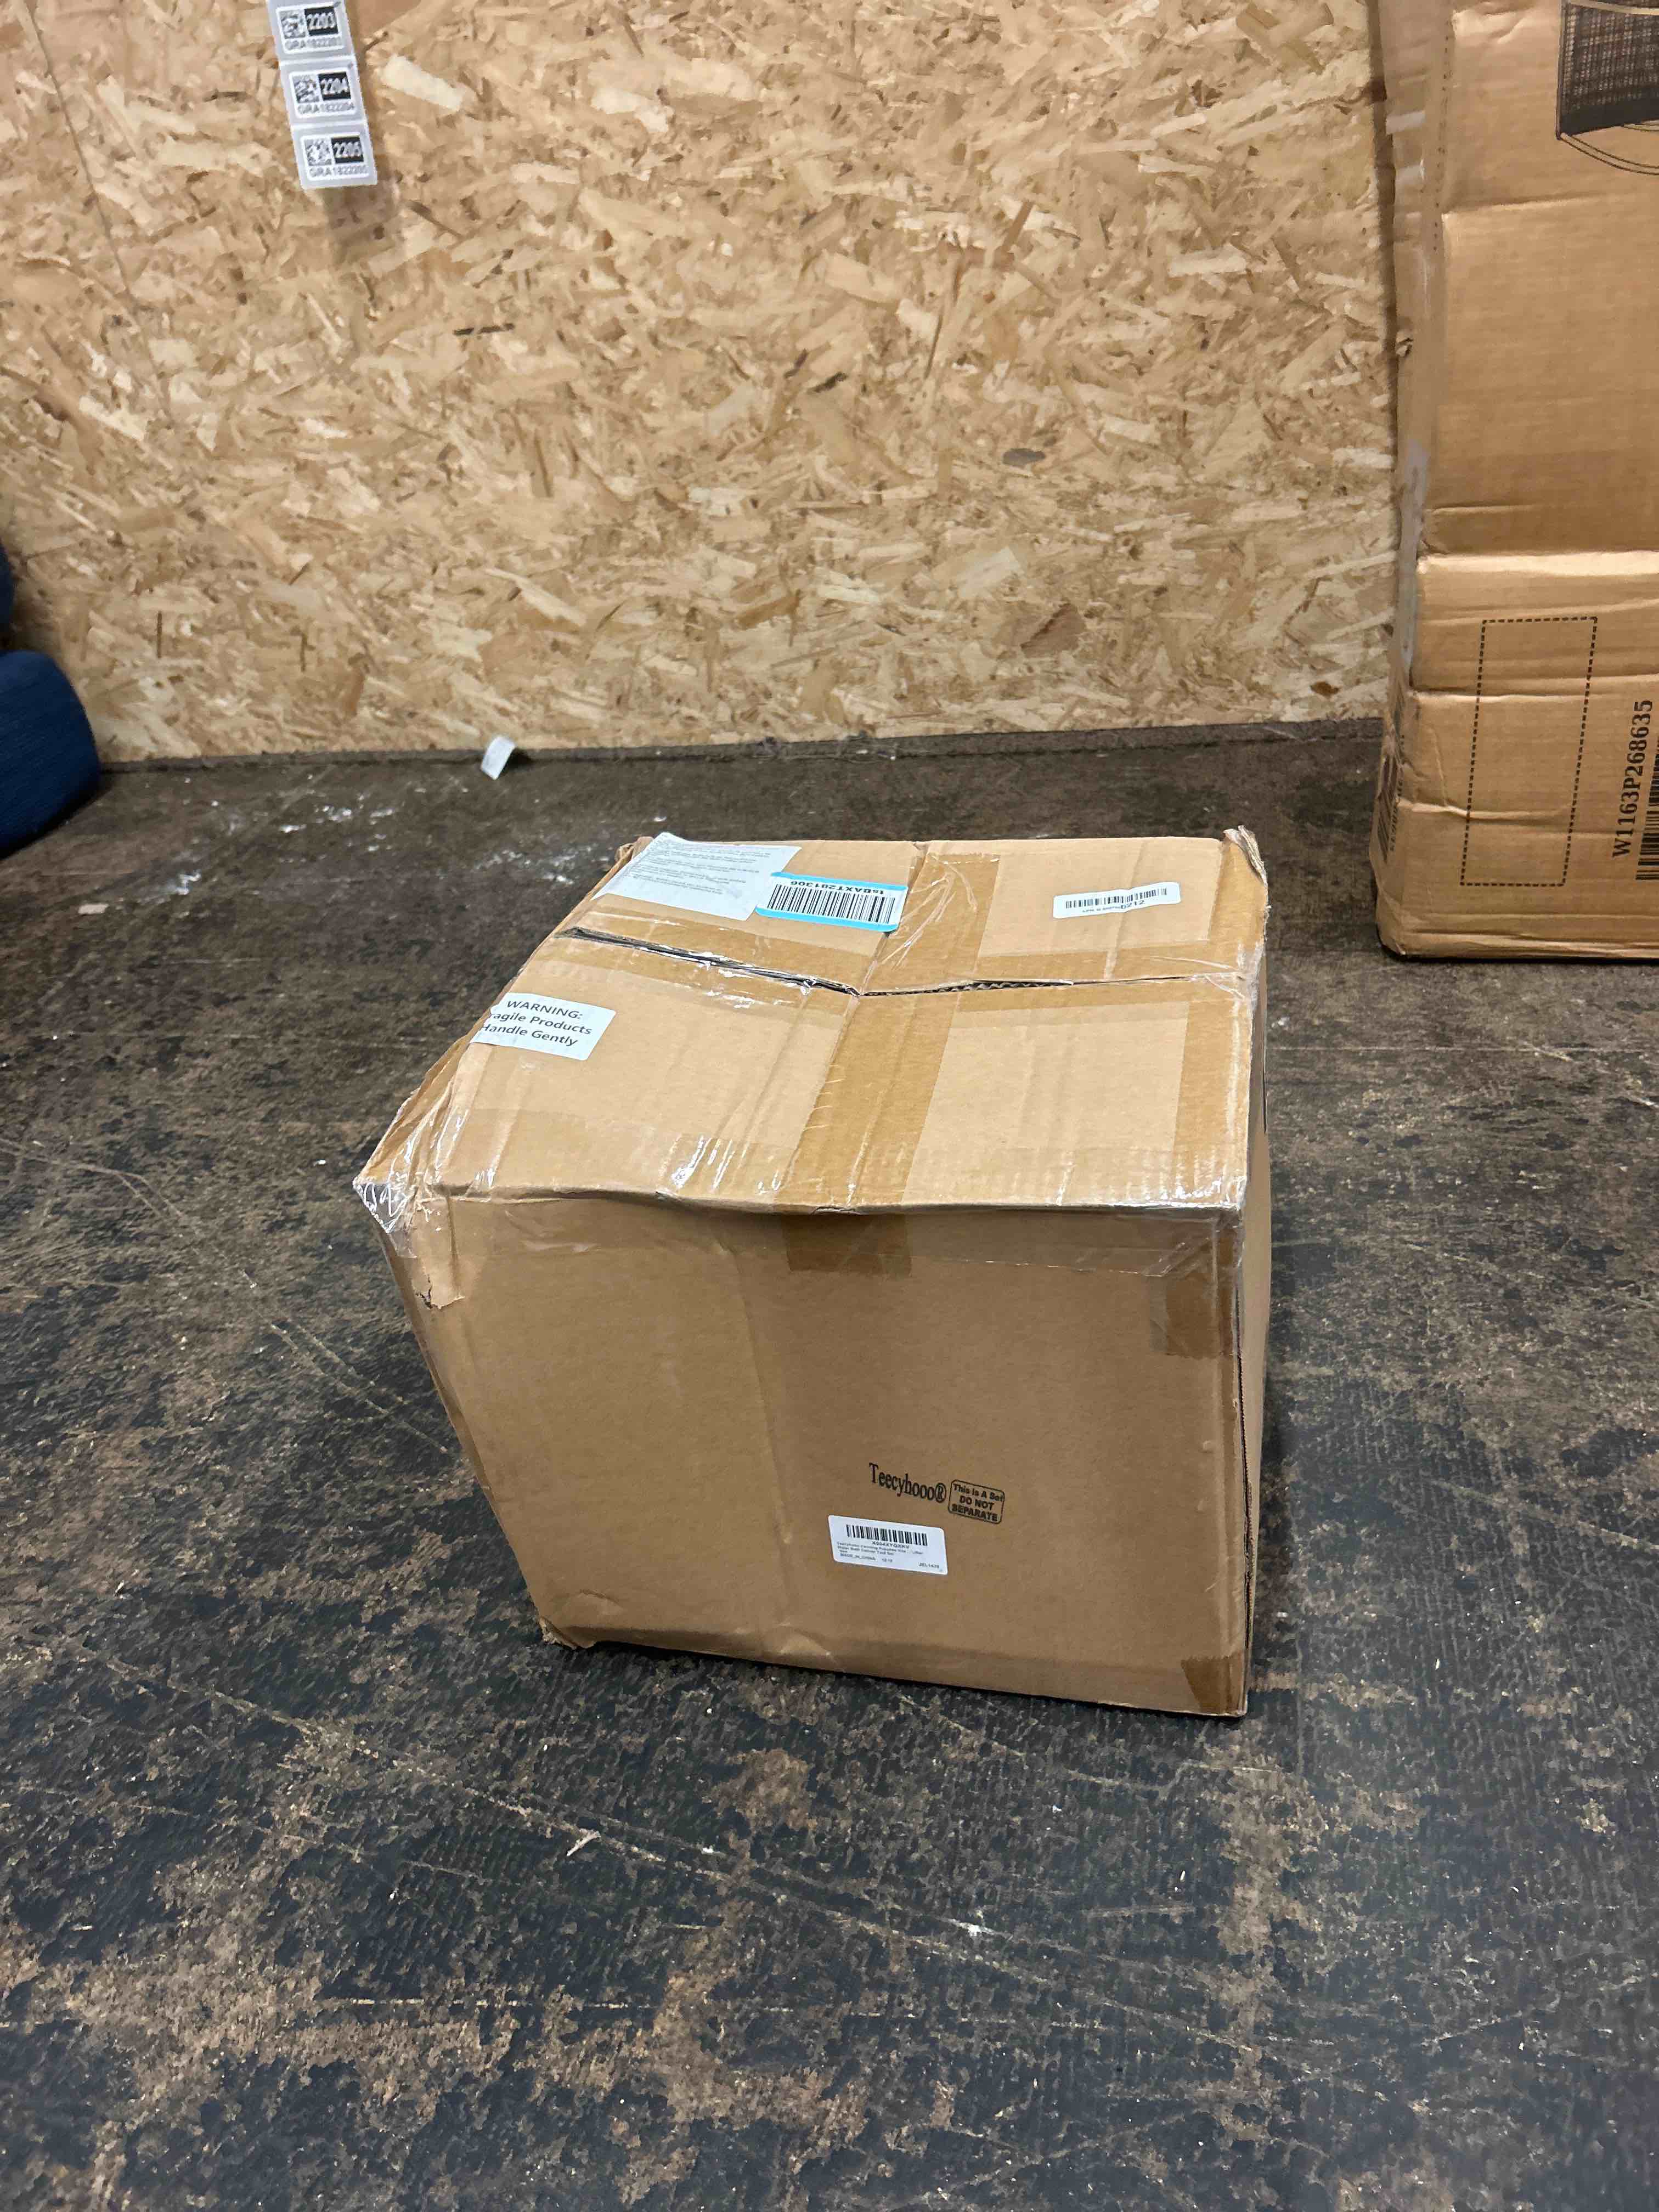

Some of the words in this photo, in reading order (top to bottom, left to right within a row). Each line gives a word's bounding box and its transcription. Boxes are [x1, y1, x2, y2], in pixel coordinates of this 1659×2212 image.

[1612, 700, 1653, 858] W1163P268635
[506, 1000, 583, 1019] WARNING:
[529, 1016, 592, 1035] Products
[531, 1030, 578, 1047] Gently
[953, 1483, 970, 1494] This
[981, 1490, 987, 1498] A
[960, 1495, 972, 1505] DO
[974, 1498, 995, 1510] NOT
[952, 1503, 998, 1522] SEPARATE
